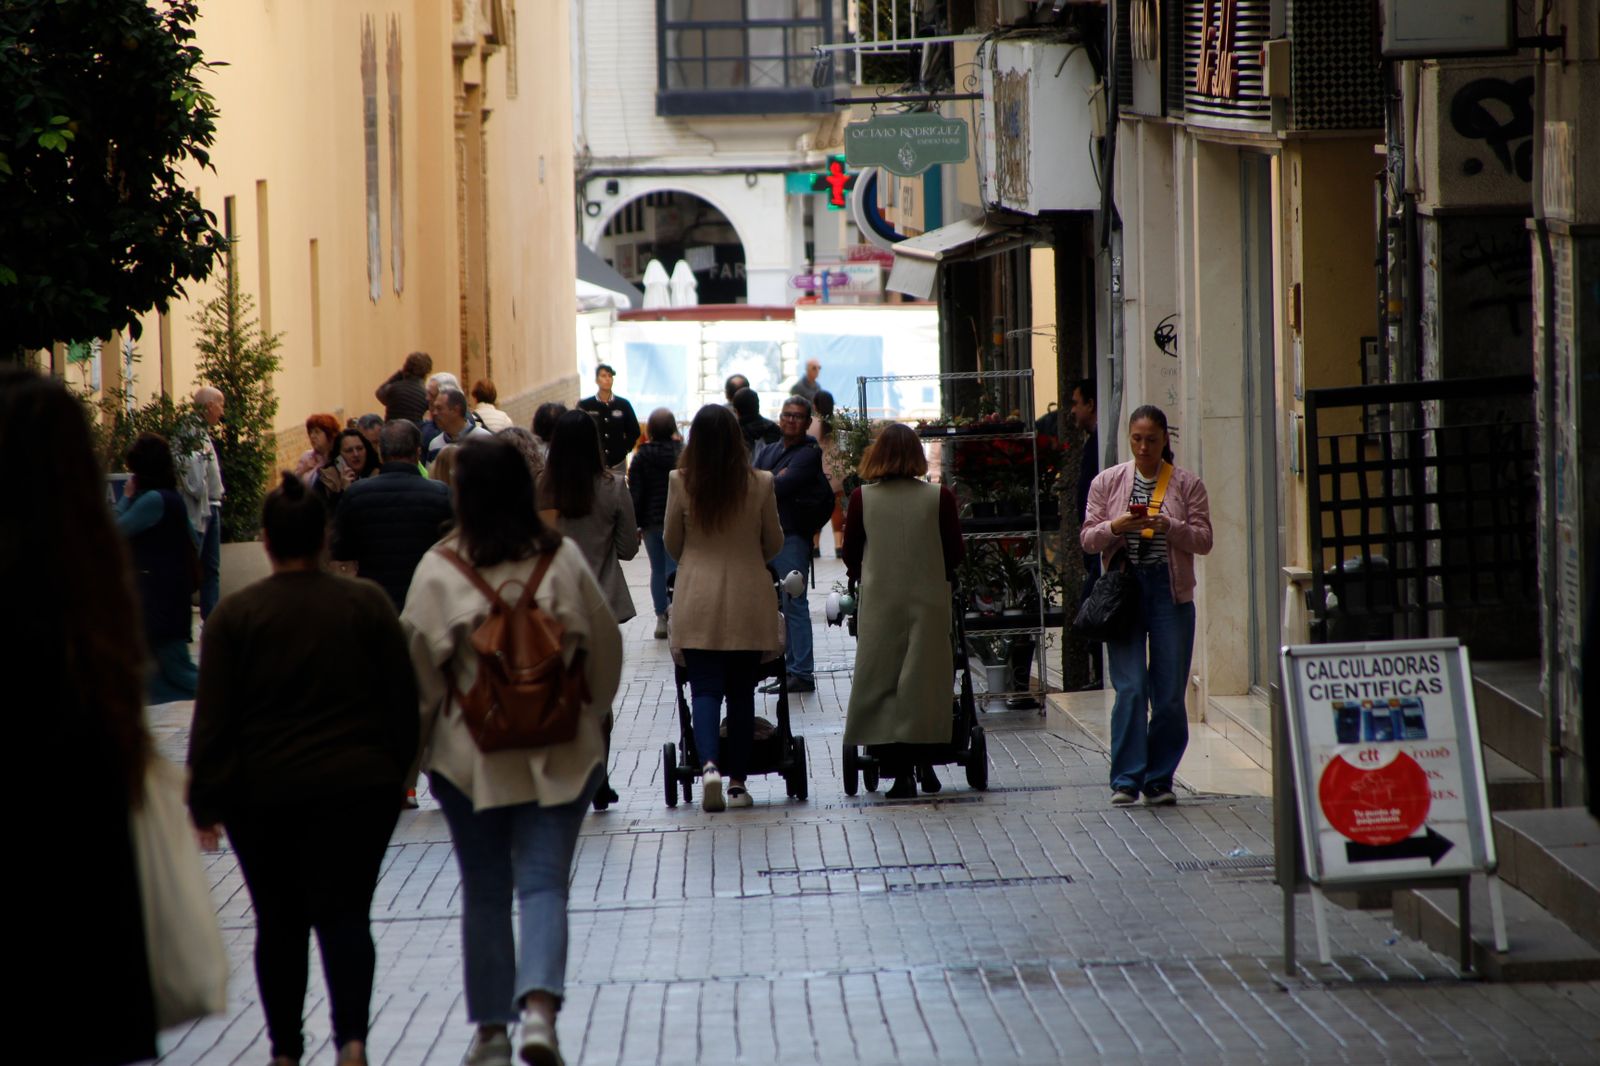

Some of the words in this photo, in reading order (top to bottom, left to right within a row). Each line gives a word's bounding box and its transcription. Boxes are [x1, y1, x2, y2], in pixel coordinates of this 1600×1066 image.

[852, 127, 897, 138] OCTAVIO
[1305, 653, 1440, 680] CALCULADORAS
[1308, 676, 1443, 701] CIENTIFICAS
